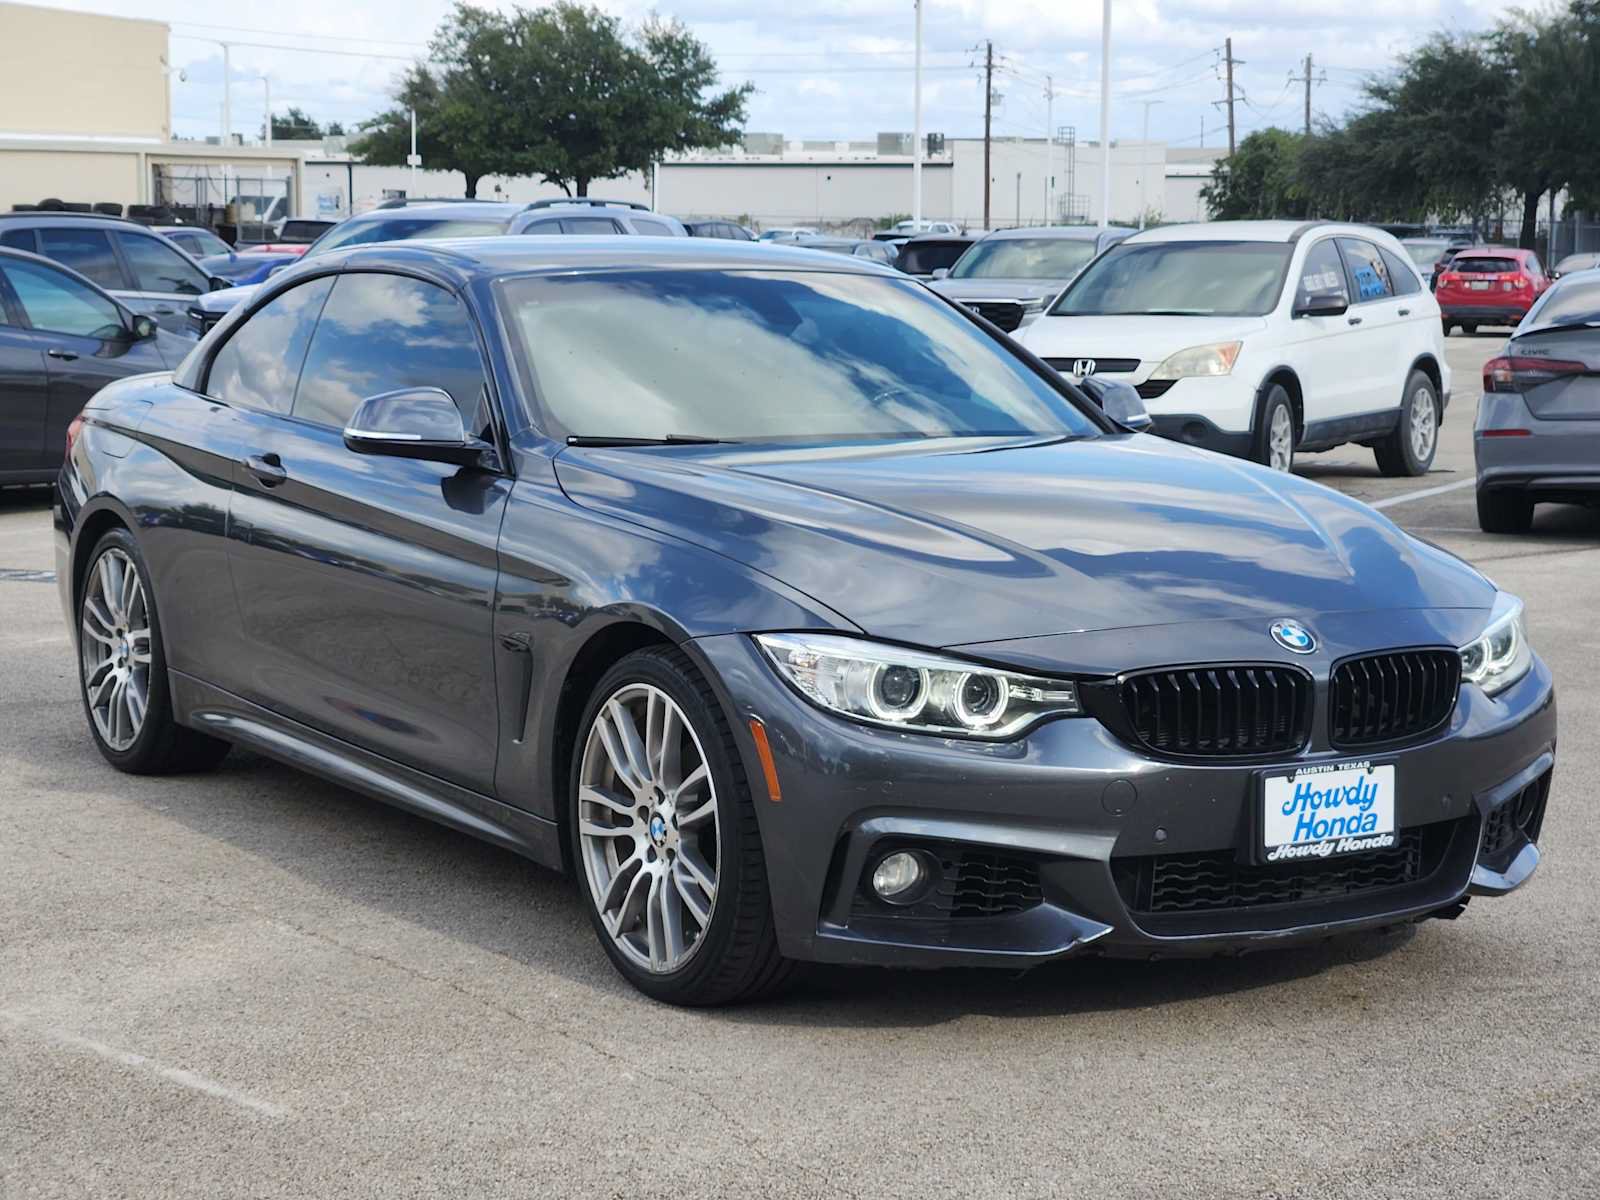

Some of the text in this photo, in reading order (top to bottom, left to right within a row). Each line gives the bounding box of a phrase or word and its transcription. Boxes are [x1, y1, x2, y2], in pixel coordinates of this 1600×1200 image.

[1521, 348, 1550, 356] CIVIC
[1295, 760, 1370, 775] AUSTIN TEXAS
[1282, 775, 1378, 816] Howdy
[1293, 812, 1378, 843] Honda
[1267, 833, 1394, 861] Howdy Honda
